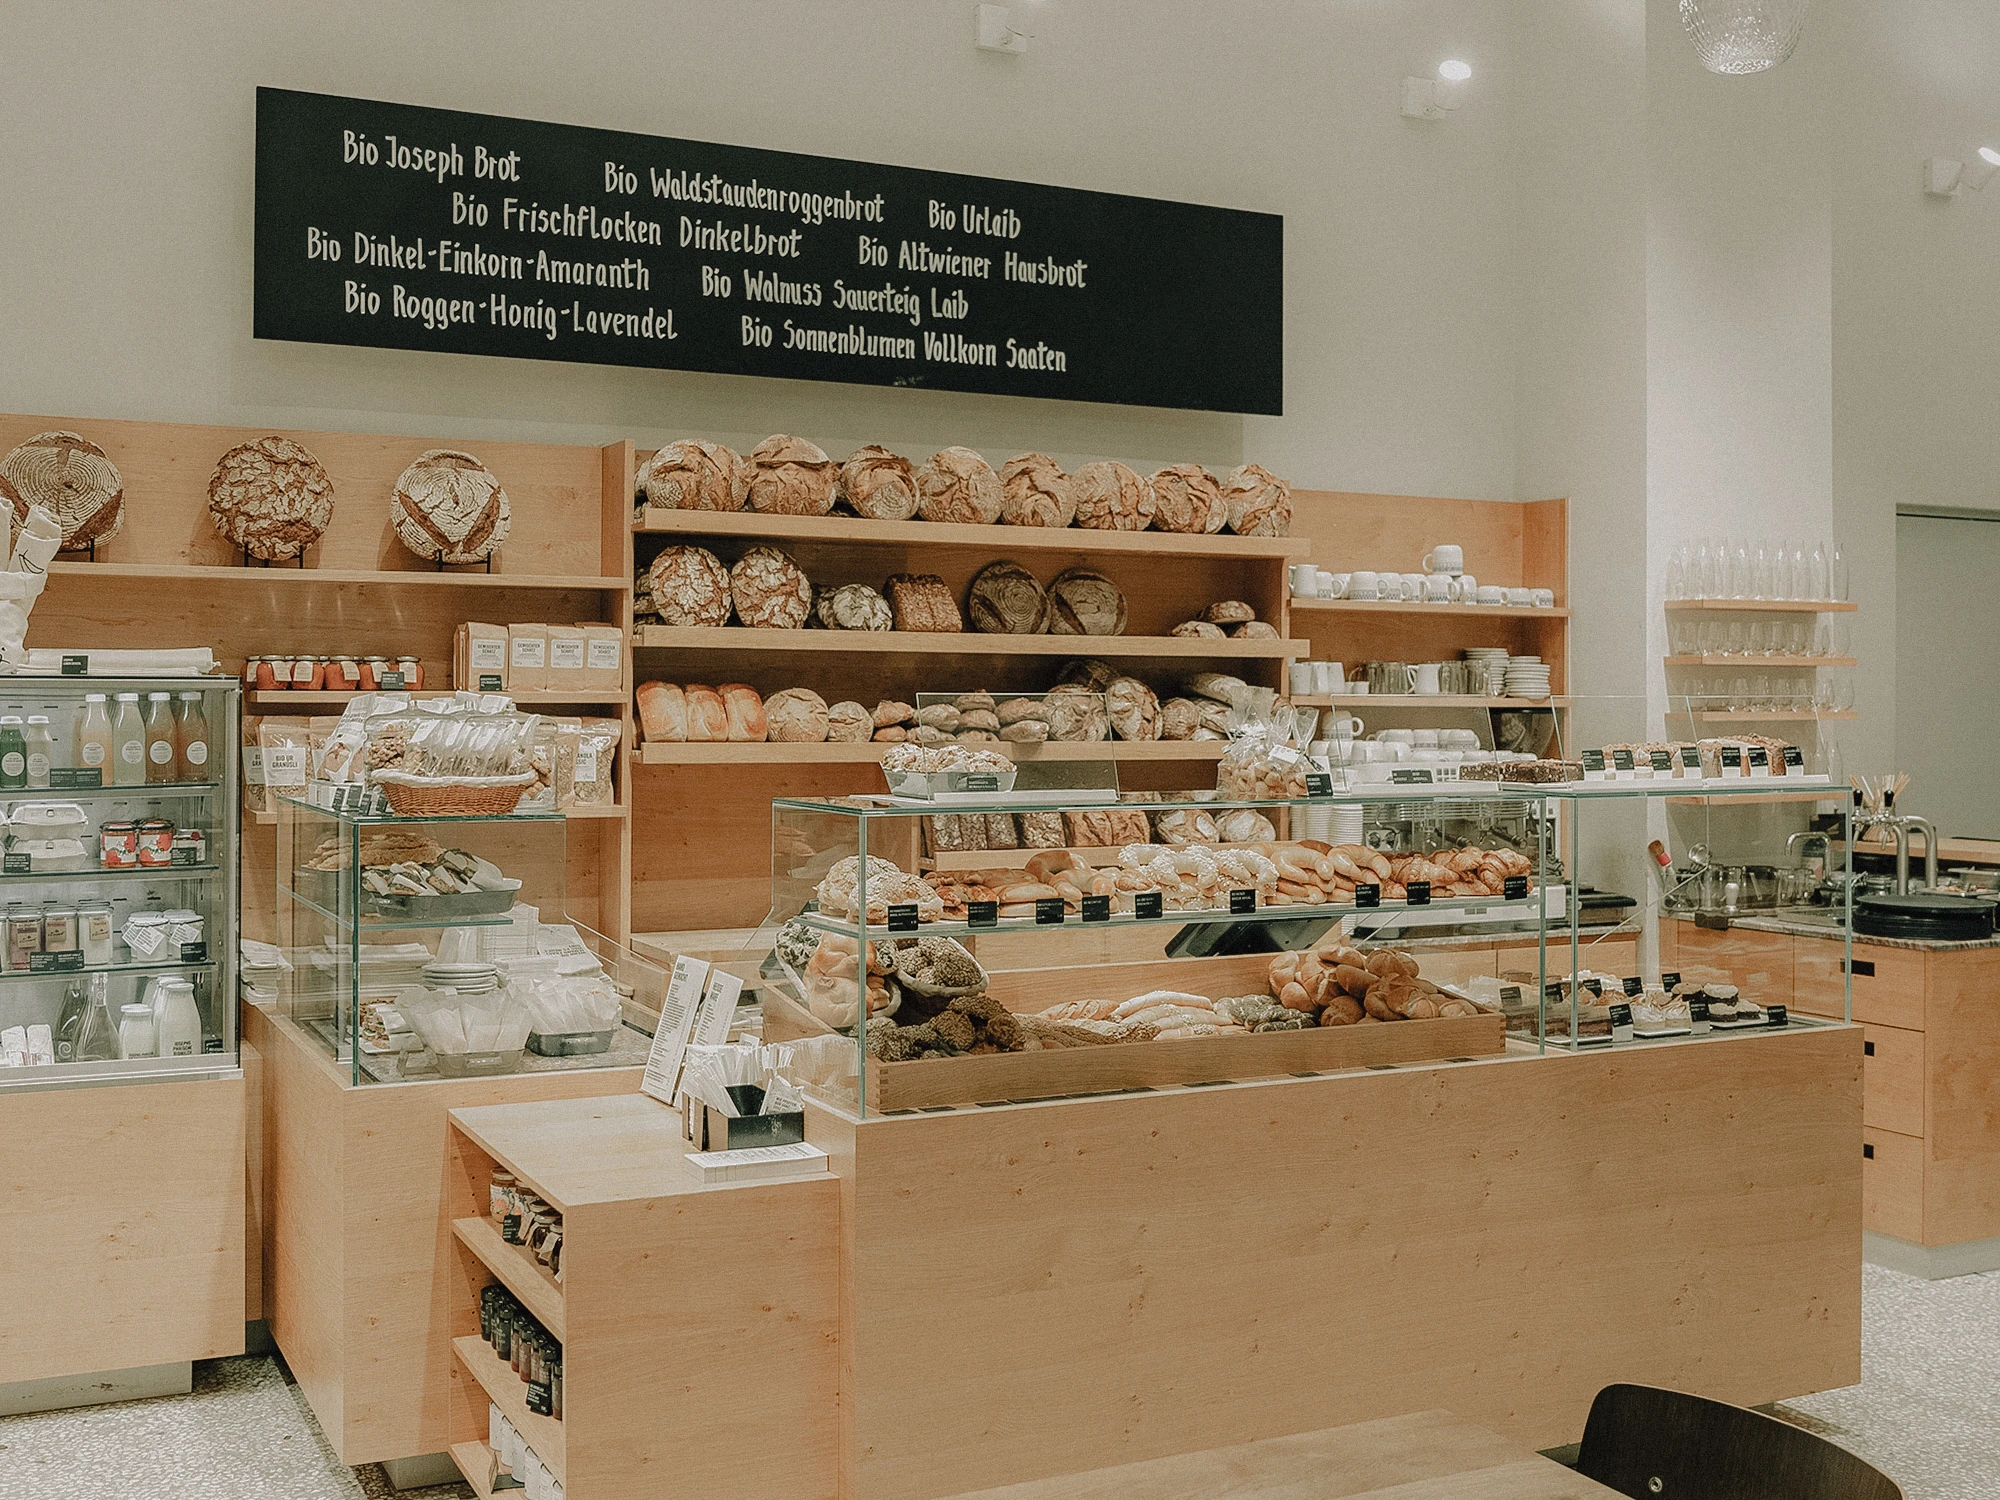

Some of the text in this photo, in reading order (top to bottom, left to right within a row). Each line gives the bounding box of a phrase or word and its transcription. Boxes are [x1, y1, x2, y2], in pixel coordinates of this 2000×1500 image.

[344, 130, 521, 184] Bio Joseph Brot
[604, 161, 885, 226] Bio Waldstaudenroggenbrot
[928, 199, 1021, 239] Bio Urlaib
[452, 191, 803, 258] Bio Frischflocken Dinkelbrot
[307, 226, 650, 291] Bio Dinkel-Einkorn-Amaranth
[859, 235, 1088, 289] Bio Altwiener Hausbrot
[344, 280, 678, 340] Bio Roggen-Honig-Lavendel
[701, 265, 969, 327] Bio Walnuss Sauerteig Laib
[741, 315, 1067, 373] Bio Sonnenblumen Vollkorn Saaten
